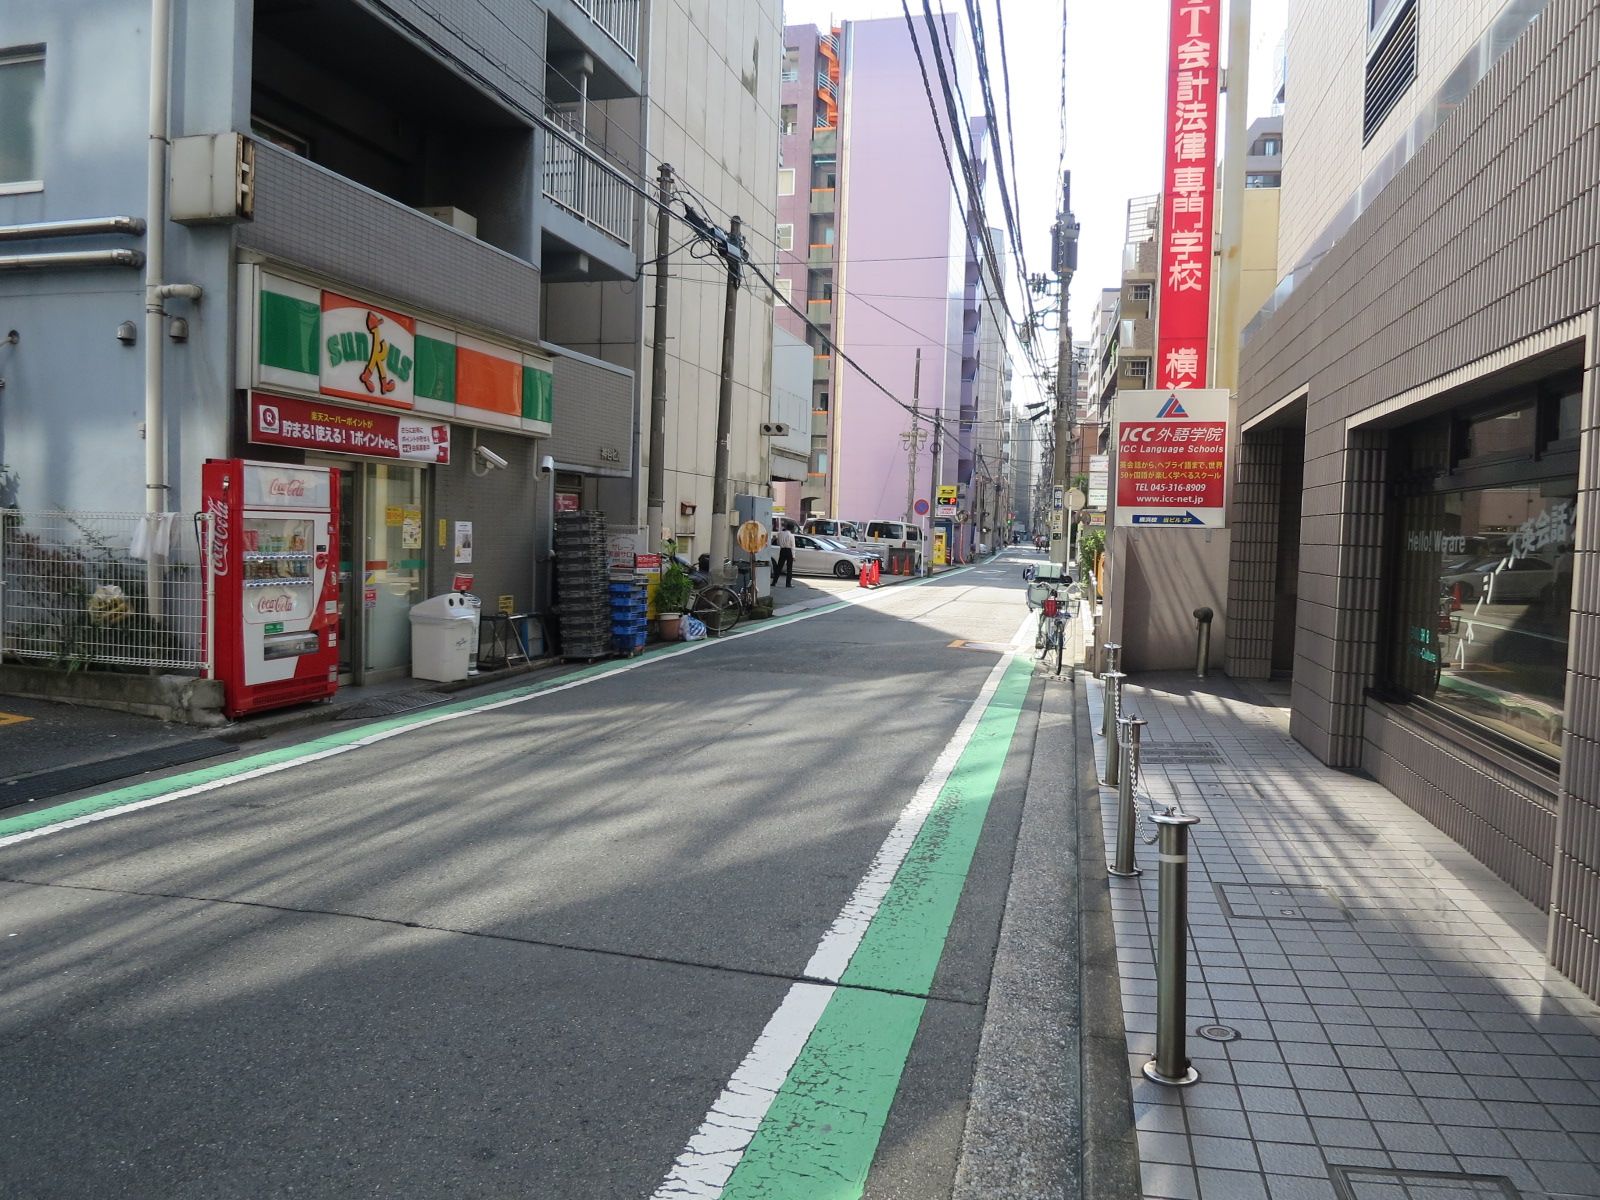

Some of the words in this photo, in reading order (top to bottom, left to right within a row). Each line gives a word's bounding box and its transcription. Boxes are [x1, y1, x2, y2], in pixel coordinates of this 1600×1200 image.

[1165, 347, 1199, 390] 横
[1121, 427, 1156, 442] ICC
[1155, 427, 1224, 442] 外語学院
[1120, 445, 1137, 453] ICC
[1140, 445, 1185, 455] Language
[1188, 445, 1224, 453] Schools
[269, 478, 305, 497] Coca-Cola
[1135, 483, 1149, 491] TEL
[1151, 483, 1206, 492] 045-316-8909
[1136, 495, 1204, 504] www.icc-net.jp
[1407, 530, 1432, 553] Hello!
[257, 594, 293, 614] Coca-Cola
